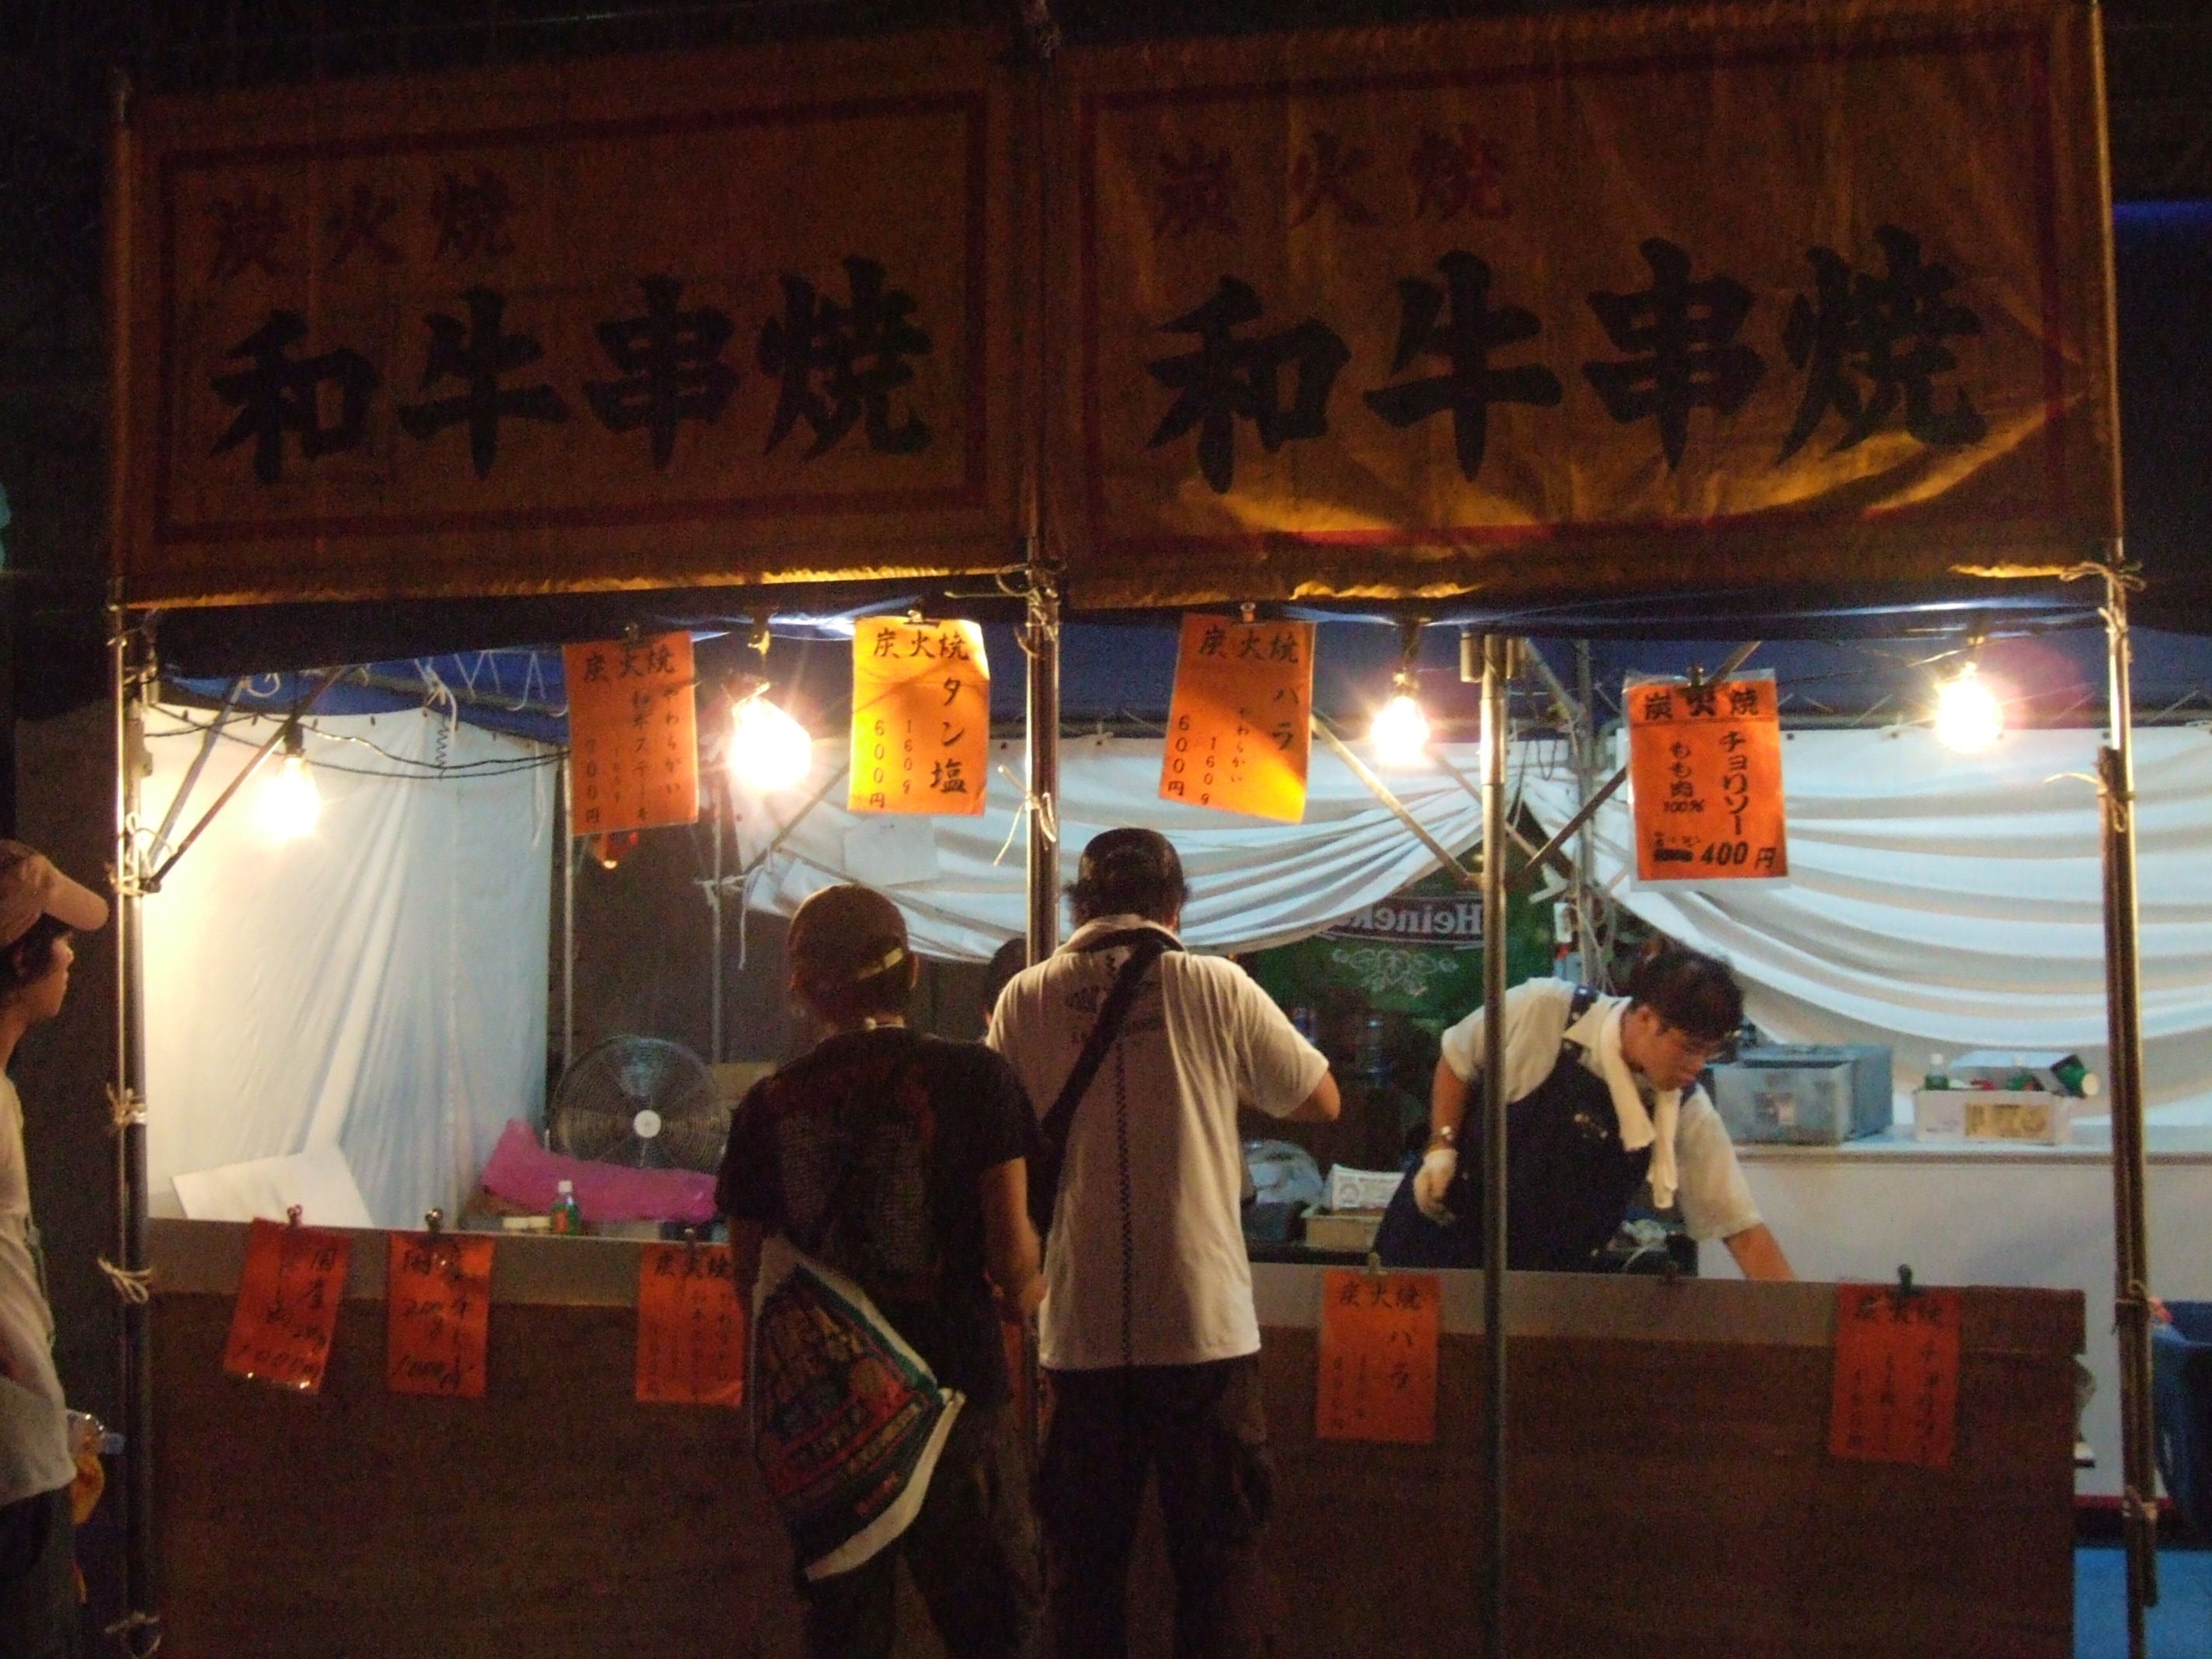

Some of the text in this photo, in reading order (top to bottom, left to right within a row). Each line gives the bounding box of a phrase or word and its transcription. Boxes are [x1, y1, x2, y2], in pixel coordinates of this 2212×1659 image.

[207, 167, 515, 281] 炭火焼
[1153, 124, 1512, 235] 炭火焼
[210, 256, 932, 483] 和牛串焼
[1147, 224, 1986, 493] 和牛串焼
[874, 628, 970, 659] 炭火焼
[1198, 625, 1299, 663] 炭火焼
[869, 719, 885, 809] 600円
[930, 676, 967, 793] タン塩
[1167, 715, 1191, 797] 600円
[1701, 841, 1777, 871] 400円
